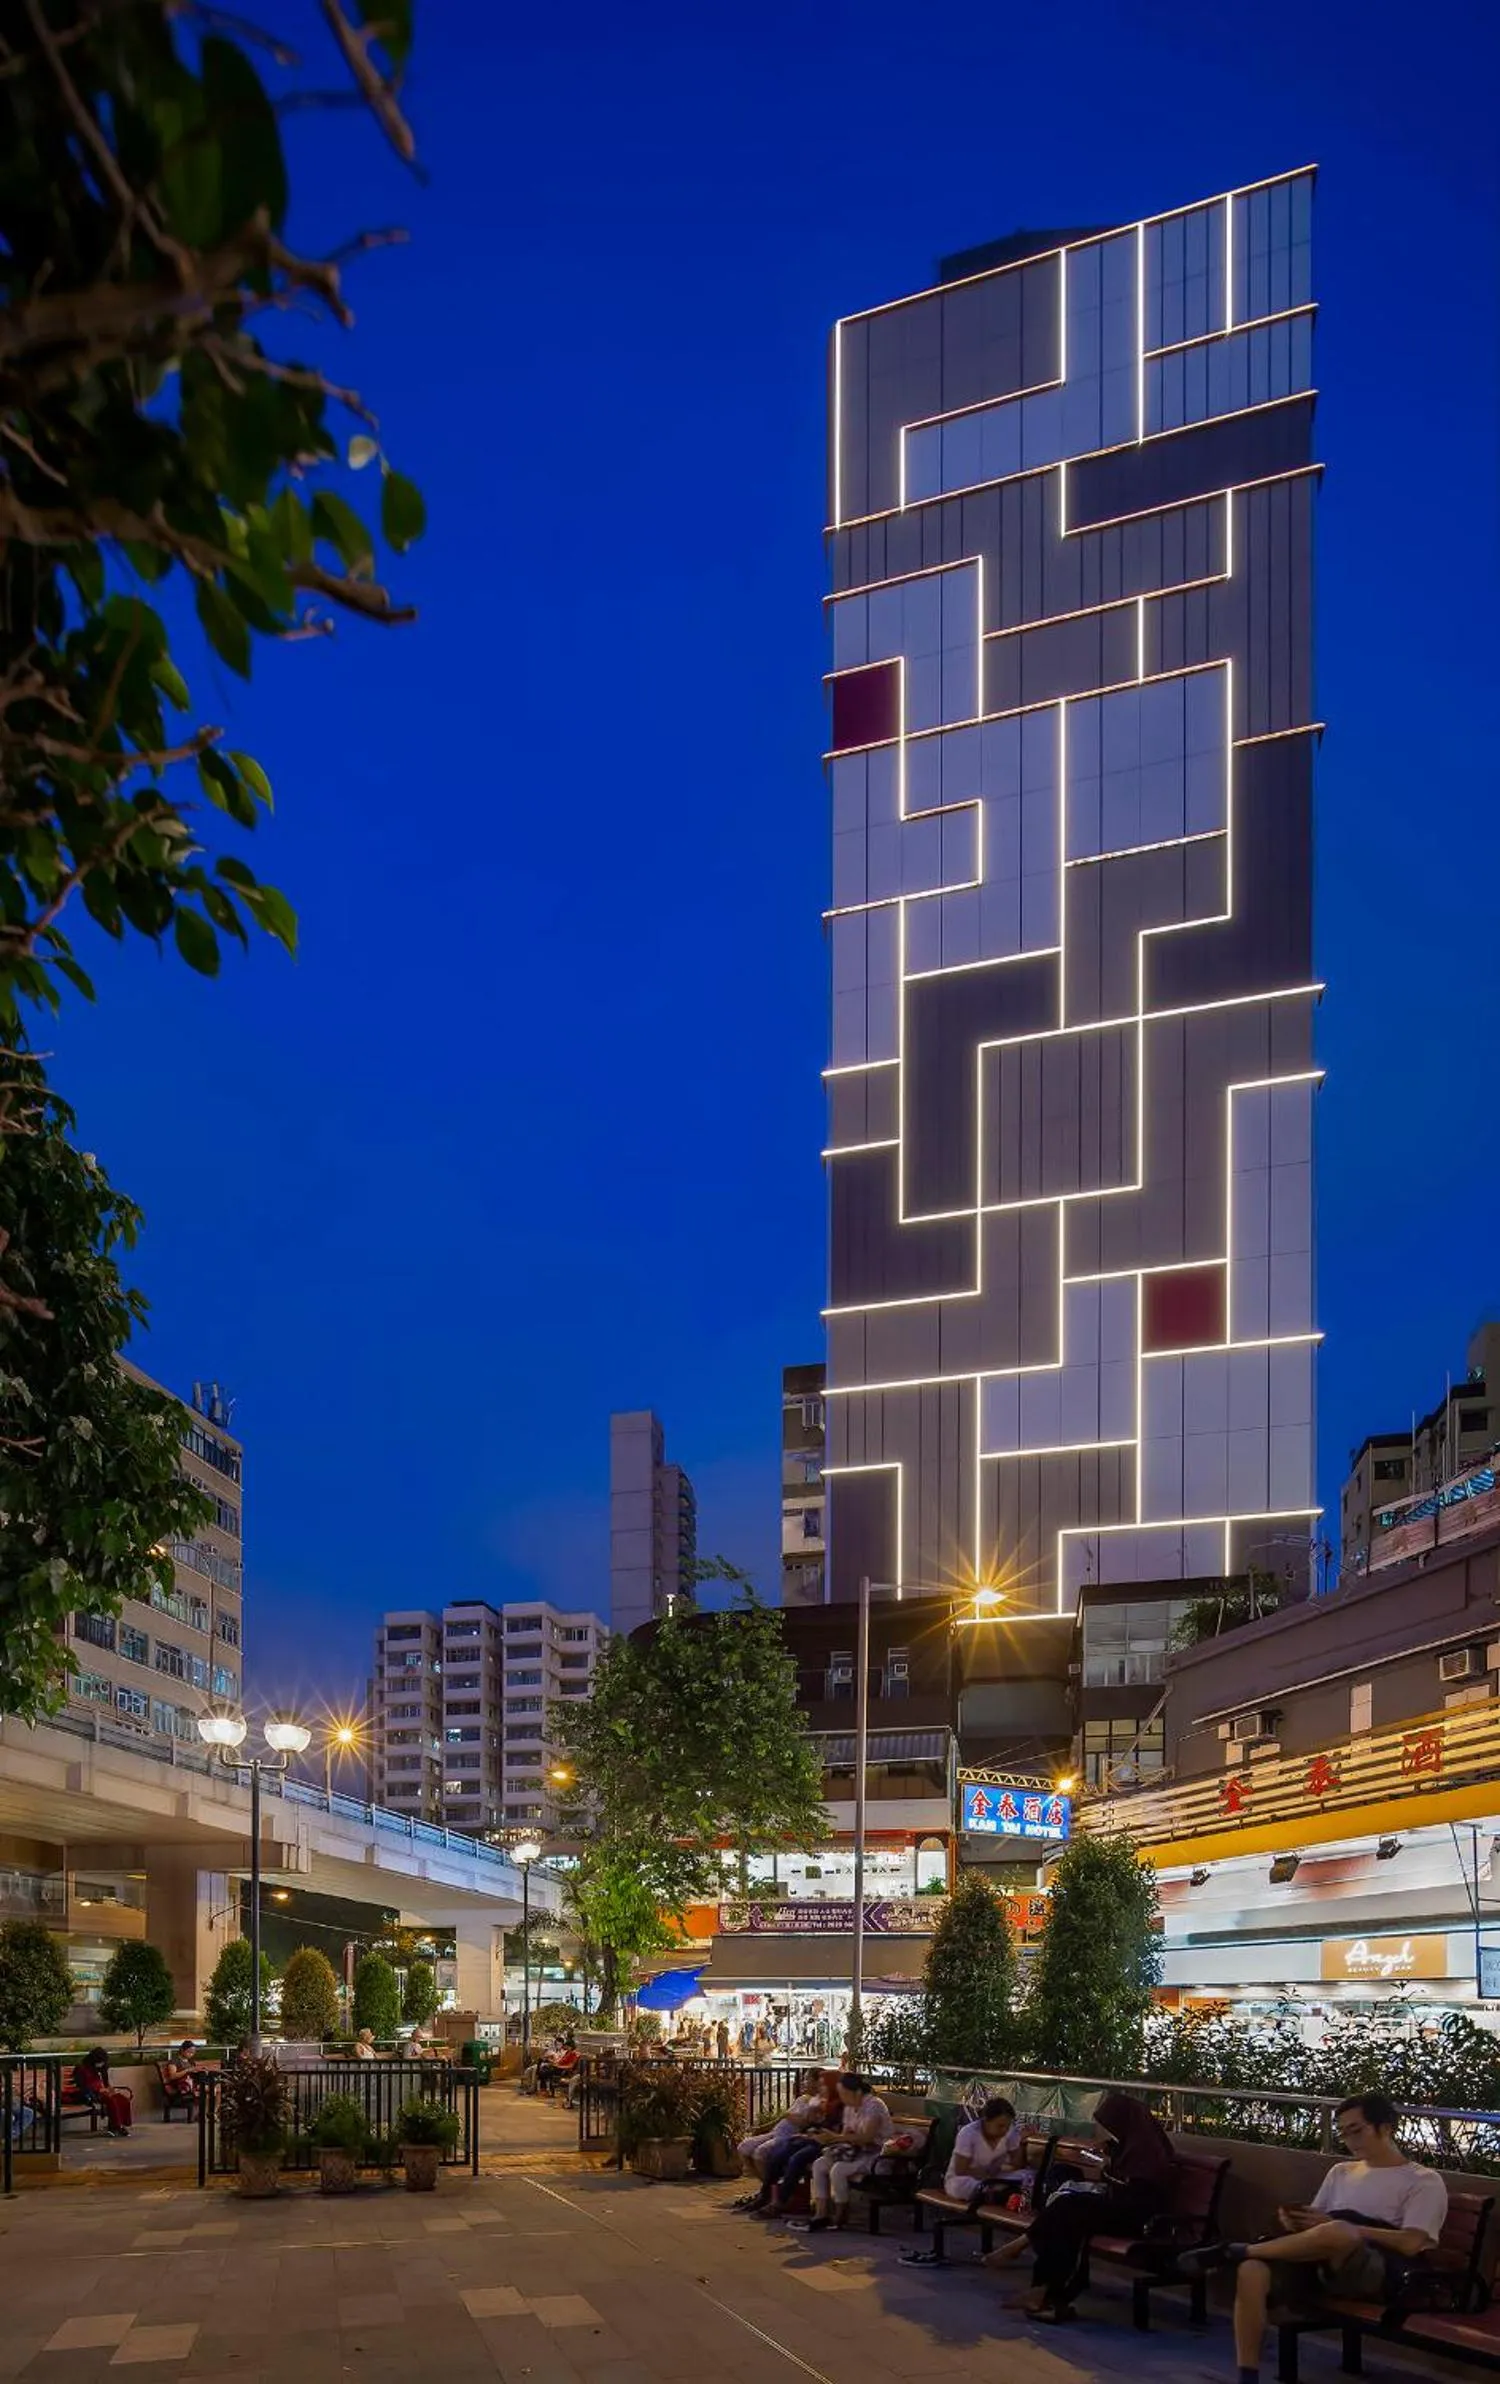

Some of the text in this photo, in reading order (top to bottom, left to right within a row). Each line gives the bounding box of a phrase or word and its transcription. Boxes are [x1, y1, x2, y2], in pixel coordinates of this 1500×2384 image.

[969, 1788, 1064, 1827] 金泰酒店
[1025, 1823, 1064, 1840] HOTEL
